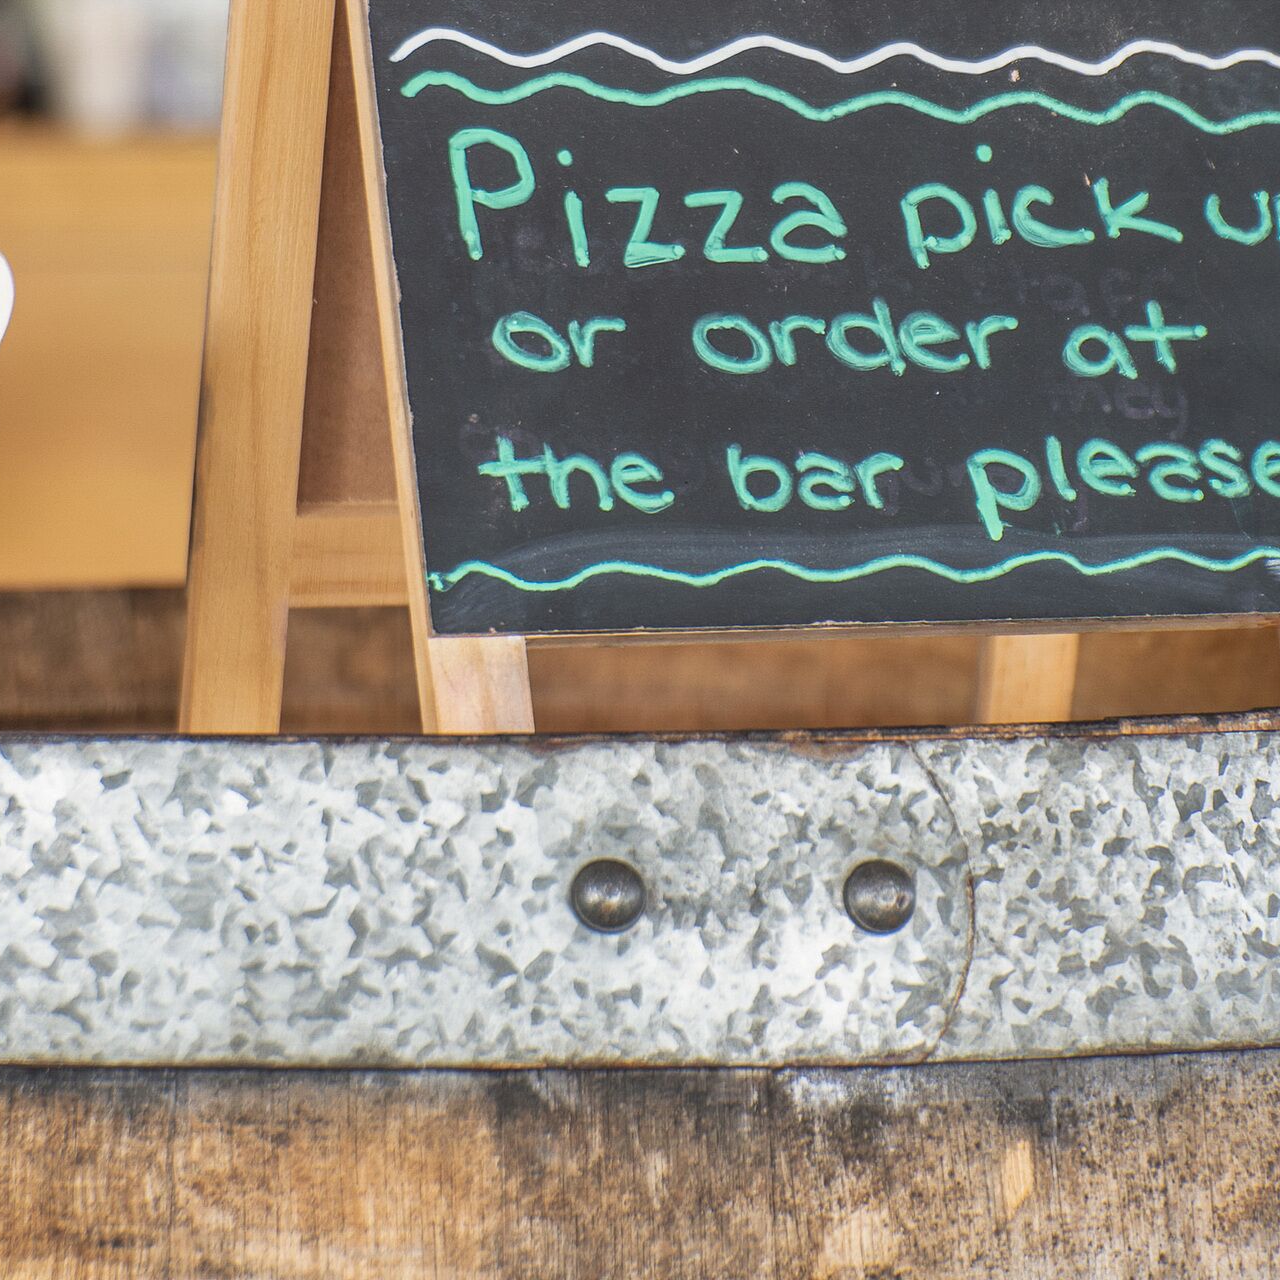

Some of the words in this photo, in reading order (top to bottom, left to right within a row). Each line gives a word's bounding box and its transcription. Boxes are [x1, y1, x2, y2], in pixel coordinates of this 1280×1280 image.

[448, 127, 848, 269] Pizza
[899, 143, 1184, 270] pick
[491, 310, 627, 373] or
[691, 297, 1019, 377] order
[1061, 300, 1209, 380] at
[477, 435, 676, 515] the
[726, 444, 905, 513] bar
